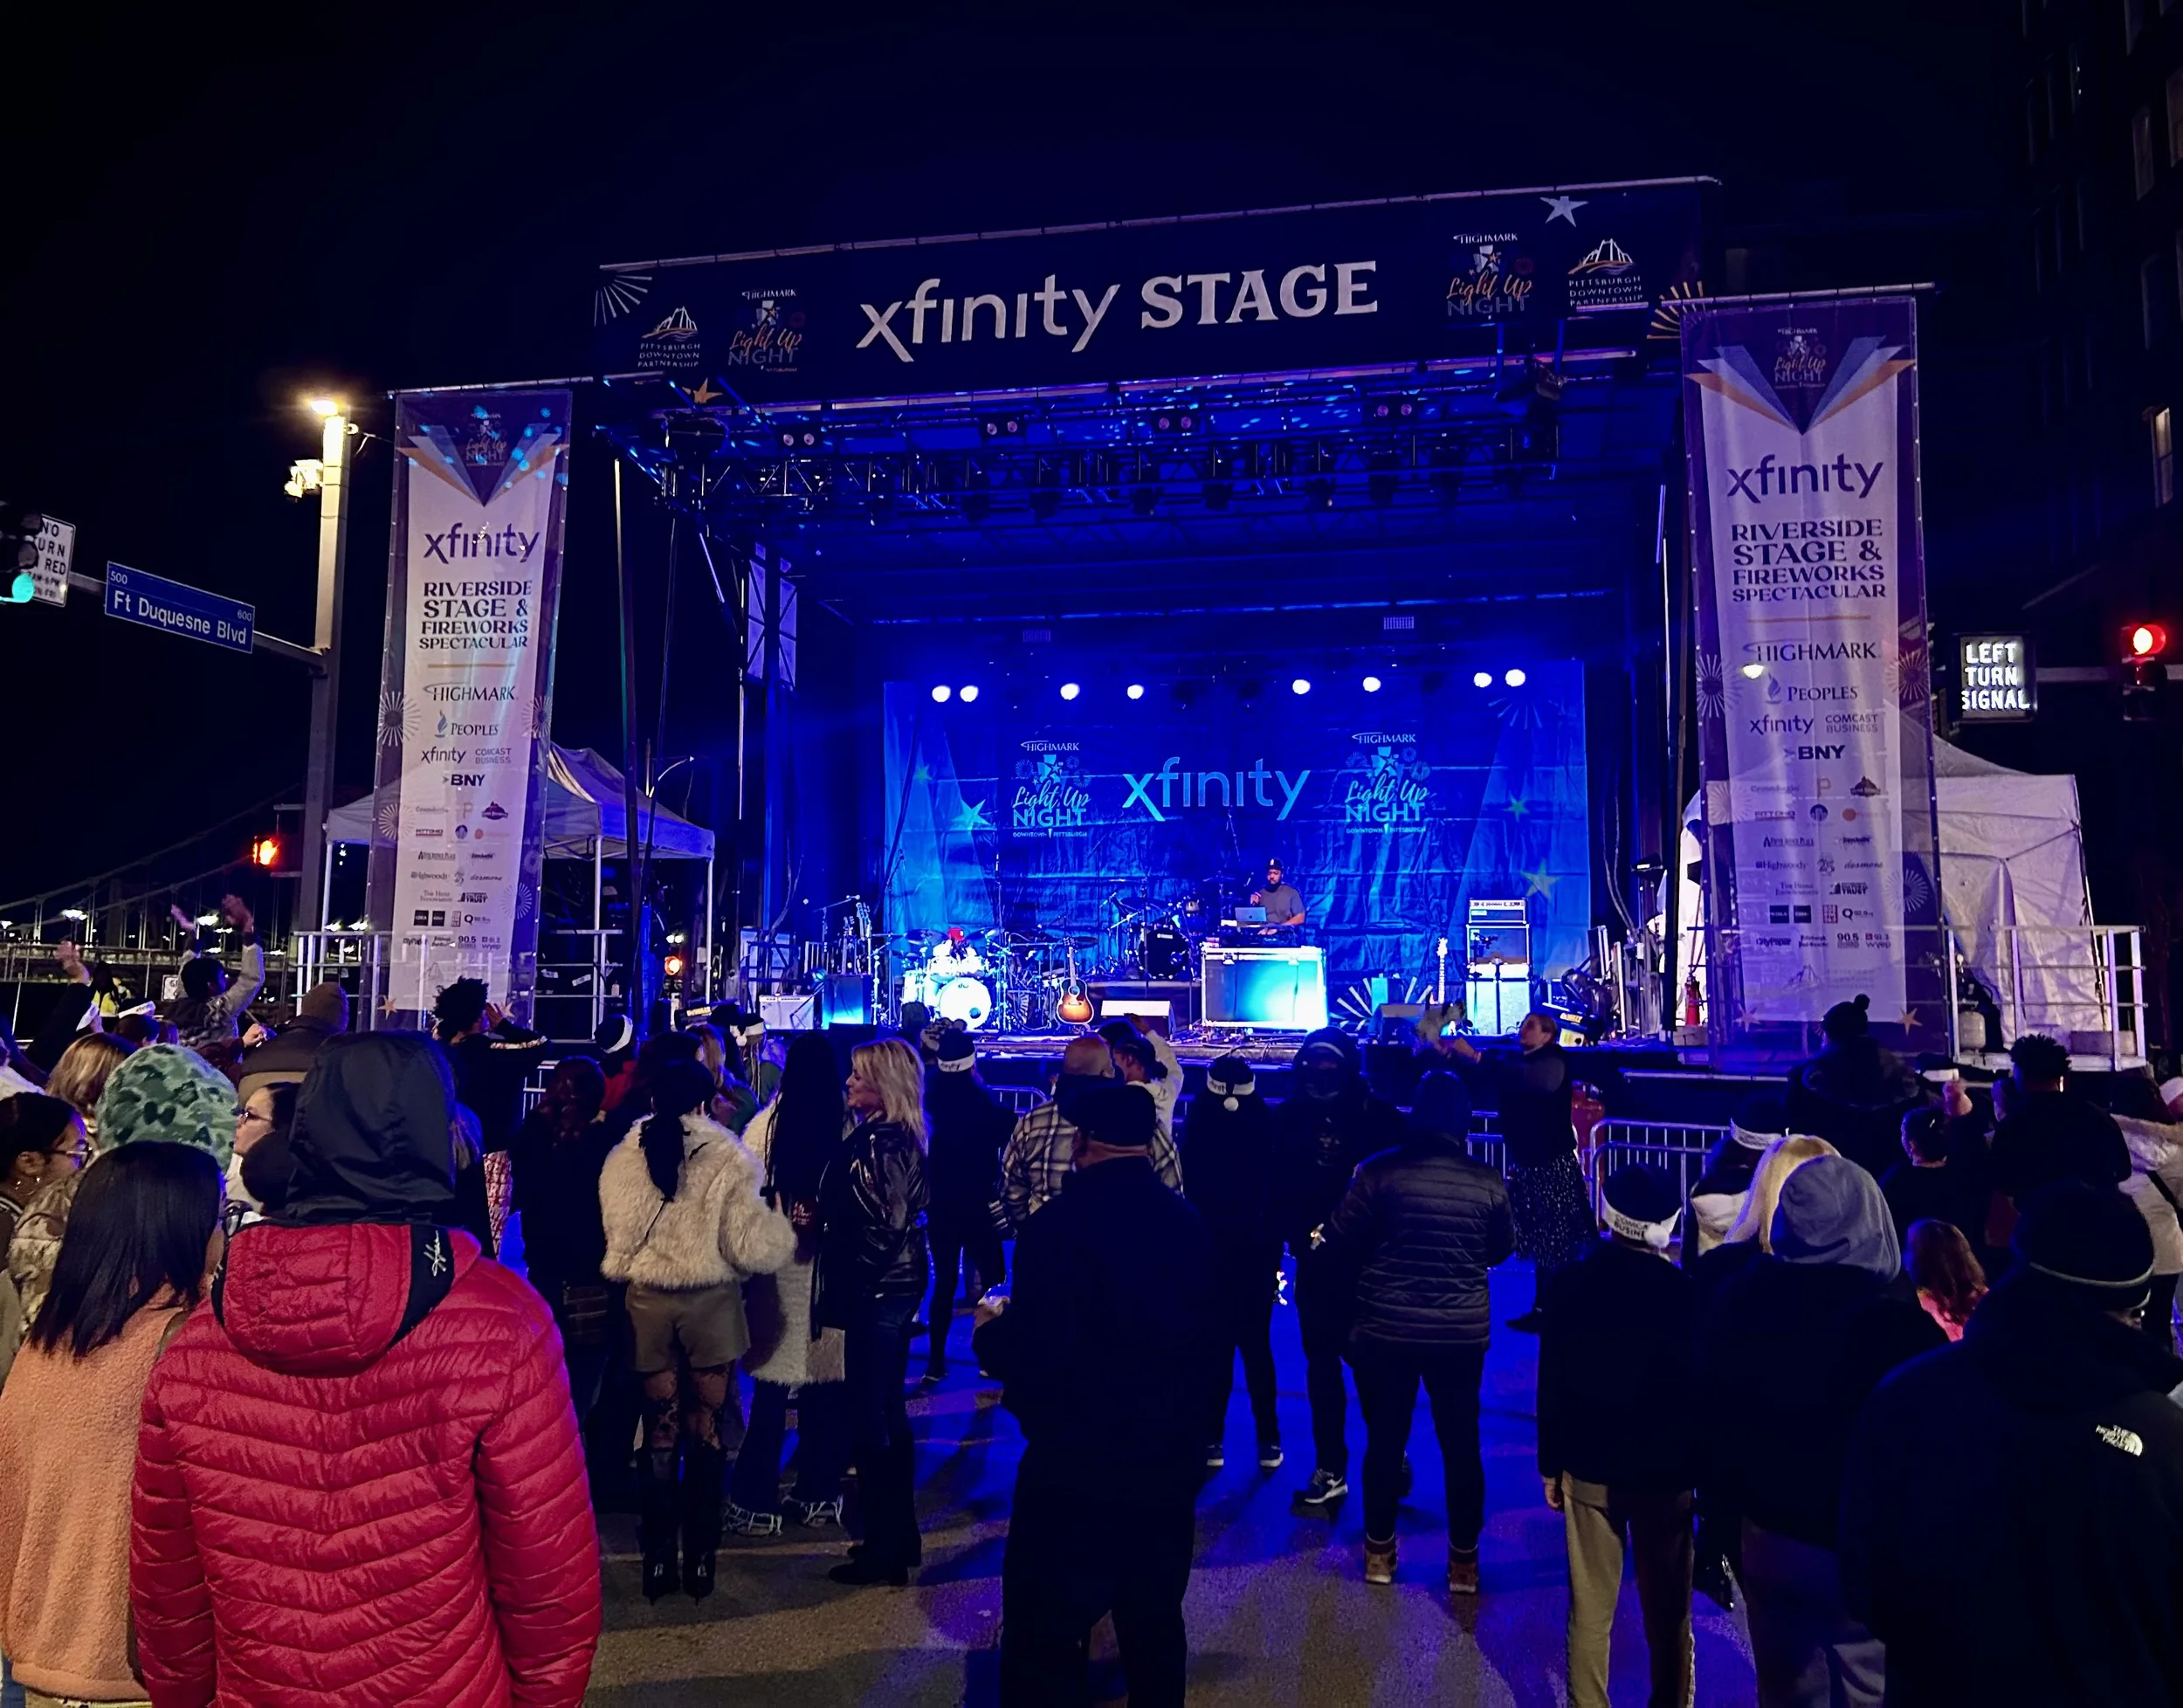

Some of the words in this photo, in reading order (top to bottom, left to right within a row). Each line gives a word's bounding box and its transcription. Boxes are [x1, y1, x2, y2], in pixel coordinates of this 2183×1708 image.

[1456, 232, 1518, 244] HIGHMARK
[1446, 270, 1498, 306] Light
[1504, 274, 1534, 301] Up
[1568, 276, 1642, 287] PITTSBURGH
[744, 289, 796, 300] HIGHMARK
[1569, 286, 1642, 298] DOWNTOWN
[1570, 294, 1644, 306] PARTNERSHIP
[856, 273, 1121, 362] xfinity
[1140, 260, 1378, 329] STAGE
[1447, 294, 1530, 316] NIGHT
[729, 323, 775, 356] Light
[776, 327, 803, 354] Up
[728, 348, 798, 366] NIGHT
[1726, 453, 1883, 504] xfinity
[1732, 519, 1883, 542] RIVERSIDE
[38, 538, 65, 557] URN
[424, 522, 541, 565] xfinity
[1732, 540, 1847, 566] STAGE
[1858, 540, 1883, 561] &
[45, 559, 66, 575] RED
[1732, 564, 1885, 586] FIREWORKS
[110, 571, 128, 585] 500
[424, 580, 533, 597] RIVERSIDE
[1732, 583, 1886, 603] SPECTACULAR
[114, 589, 131, 612] Ft
[138, 597, 210, 635] Duquesne
[217, 621, 246, 644] Blvd
[237, 609, 251, 622] 600
[424, 598, 506, 618] STAGE
[516, 598, 529, 617] &
[421, 619, 528, 636] FIREWORKS
[419, 637, 527, 650] SPECTACULAR
[1752, 640, 1877, 662] HIGHMARK
[1966, 642, 2017, 664] LEFT
[1965, 666, 2018, 686] TURN
[428, 684, 516, 701] HIGHMARK
[1787, 685, 1858, 701] PEOPLES
[1961, 689, 2030, 710] SIGNAL
[451, 723, 499, 736] PEOPLES
[1750, 714, 1815, 735] xfinity
[1825, 713, 1878, 723] COMCAST
[1826, 723, 1878, 733] BUSINESS
[1024, 741, 1079, 752] HIGHMARK
[1356, 733, 1416, 744] HIGHMARK
[421, 747, 467, 764] xfinity
[1798, 745, 1845, 760] BNY
[451, 775, 485, 786] BNY
[1122, 756, 1311, 821] xfinity
[1012, 780, 1059, 816] Light
[1064, 786, 1092, 815] Up
[1345, 773, 1395, 808] Light
[1400, 780, 1429, 809] Up
[1013, 809, 1086, 826] NIGHT
[1346, 802, 1425, 822] NIGHT
[464, 914, 474, 926] Q
[1842, 908, 1853, 921] Q
[1837, 933, 1859, 941] 90.5
